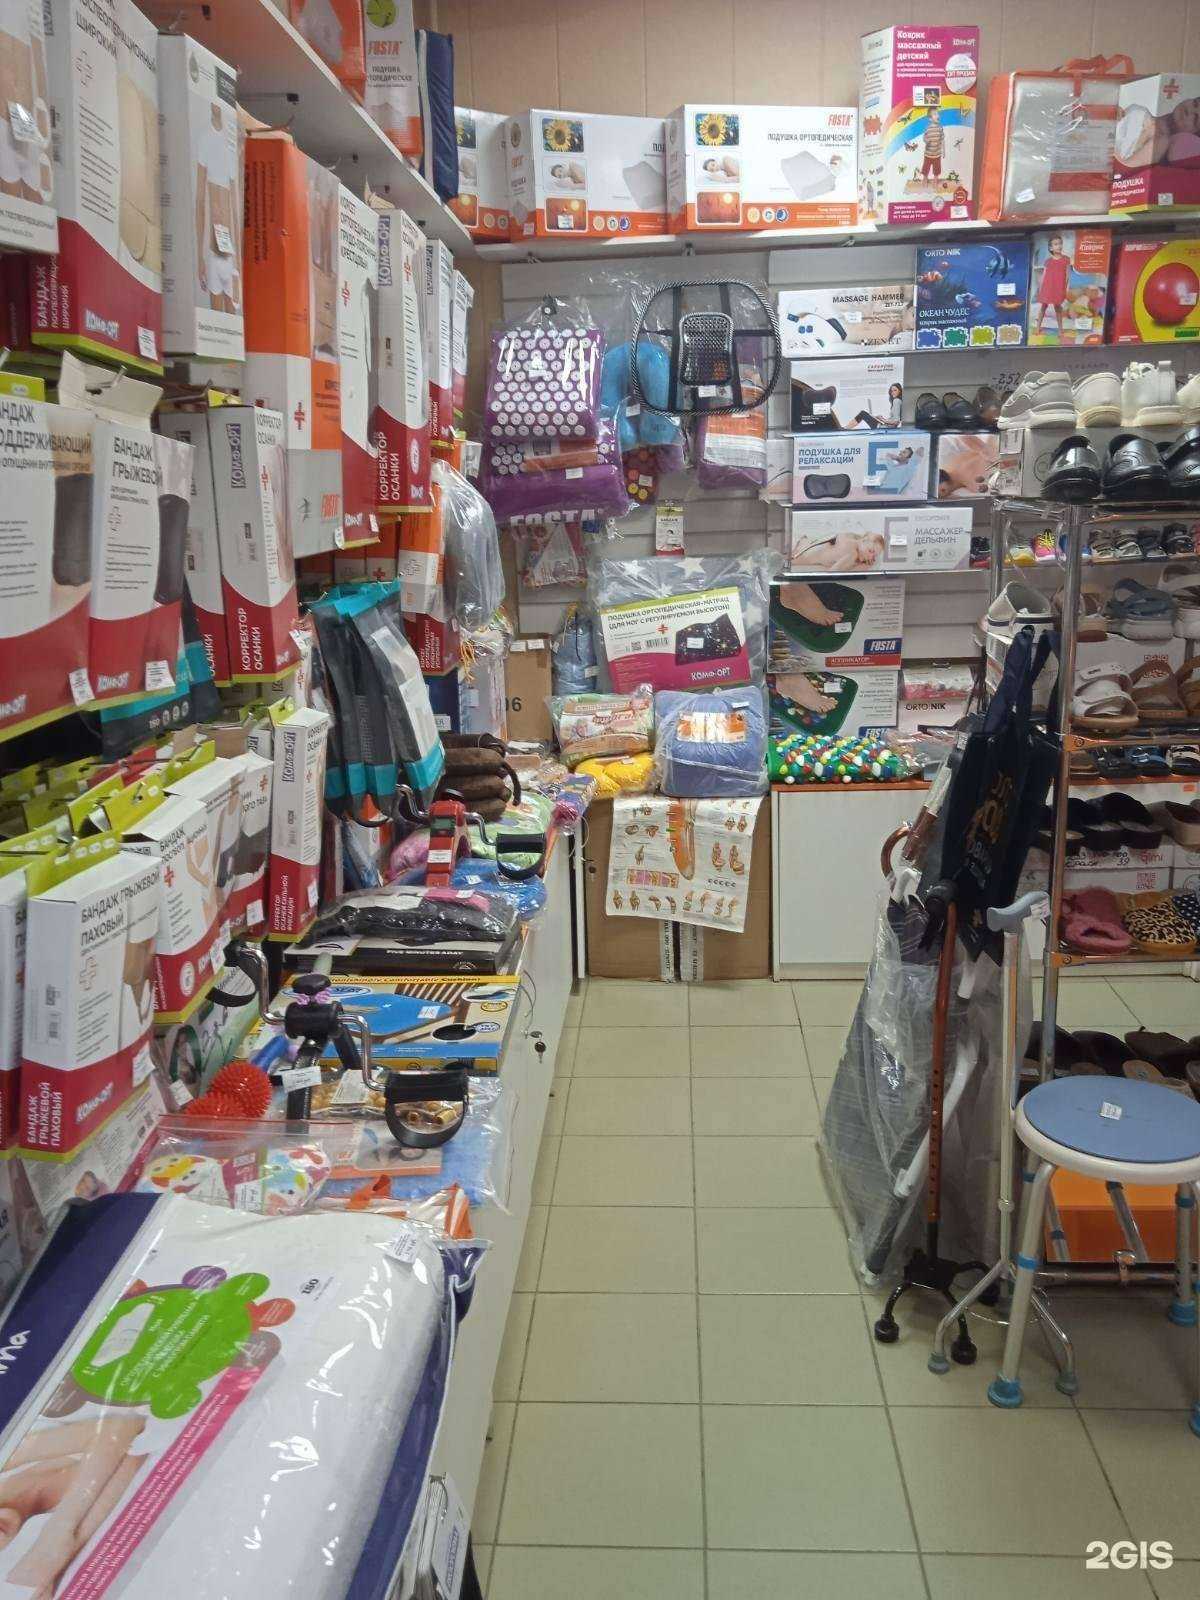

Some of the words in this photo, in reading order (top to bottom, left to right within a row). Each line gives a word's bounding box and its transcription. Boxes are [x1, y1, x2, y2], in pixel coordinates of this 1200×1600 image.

[897, 30, 925, 40] Коврик
[897, 41, 941, 50] массажный
[897, 52, 929, 61] детский
[828, 114, 850, 127] FOSTA
[767, 133, 798, 142] ПОДУШКА
[799, 133, 853, 142] ОРТОПЕДИЧЕСКАЯ
[1112, 177, 1144, 190] ПОДУШКА
[924, 249, 945, 258] ORTO
[946, 248, 961, 257] NIK
[36, 264, 49, 329] БАНДАЖ
[832, 294, 869, 304] MASSAGE
[872, 292, 905, 302] HAMMER
[919, 308, 944, 318] ОКЕАН
[945, 306, 970, 317] ЧУДЕС
[0, 403, 35, 426] НДАЖ
[0, 428, 92, 457] ОДДЕРЖИВАЮЩИЙ
[114, 437, 153, 463] БАНДАЖ
[798, 448, 842, 457] ПОДУШКА
[843, 448, 861, 456] ДЛЯ
[379, 431, 388, 501] КОРРЕКТОР
[798, 456, 854, 465] РЕЛАКСАЦИИ
[112, 461, 163, 488] ГРЫЖЕВОЙ
[392, 453, 401, 501] ОСАНКИ
[914, 527, 964, 536] МАССАЖЕР
[914, 536, 957, 545] ДЕЛЬФИН
[608, 611, 641, 622] ПОДУШКА
[645, 609, 695, 623] РЕГУЛИРУЕМОЙ
[238, 607, 250, 672] КОРРЕКТОР
[870, 640, 897, 652] FOSTA
[251, 626, 263, 671] ОСАНКИ
[905, 703, 929, 712] ORTO
[930, 702, 946, 711] NIK
[81, 891, 119, 924] БАНДАЖ
[120, 868, 161, 904] ГРЫЖЕВОЙ
[80, 913, 125, 947] ПАХОВЫЙ
[27, 1094, 38, 1144] БАНДАЖ
[39, 1082, 51, 1145] ГРЫЖЕВОЙ
[51, 1091, 63, 1146] ПАХОВЫЙ
